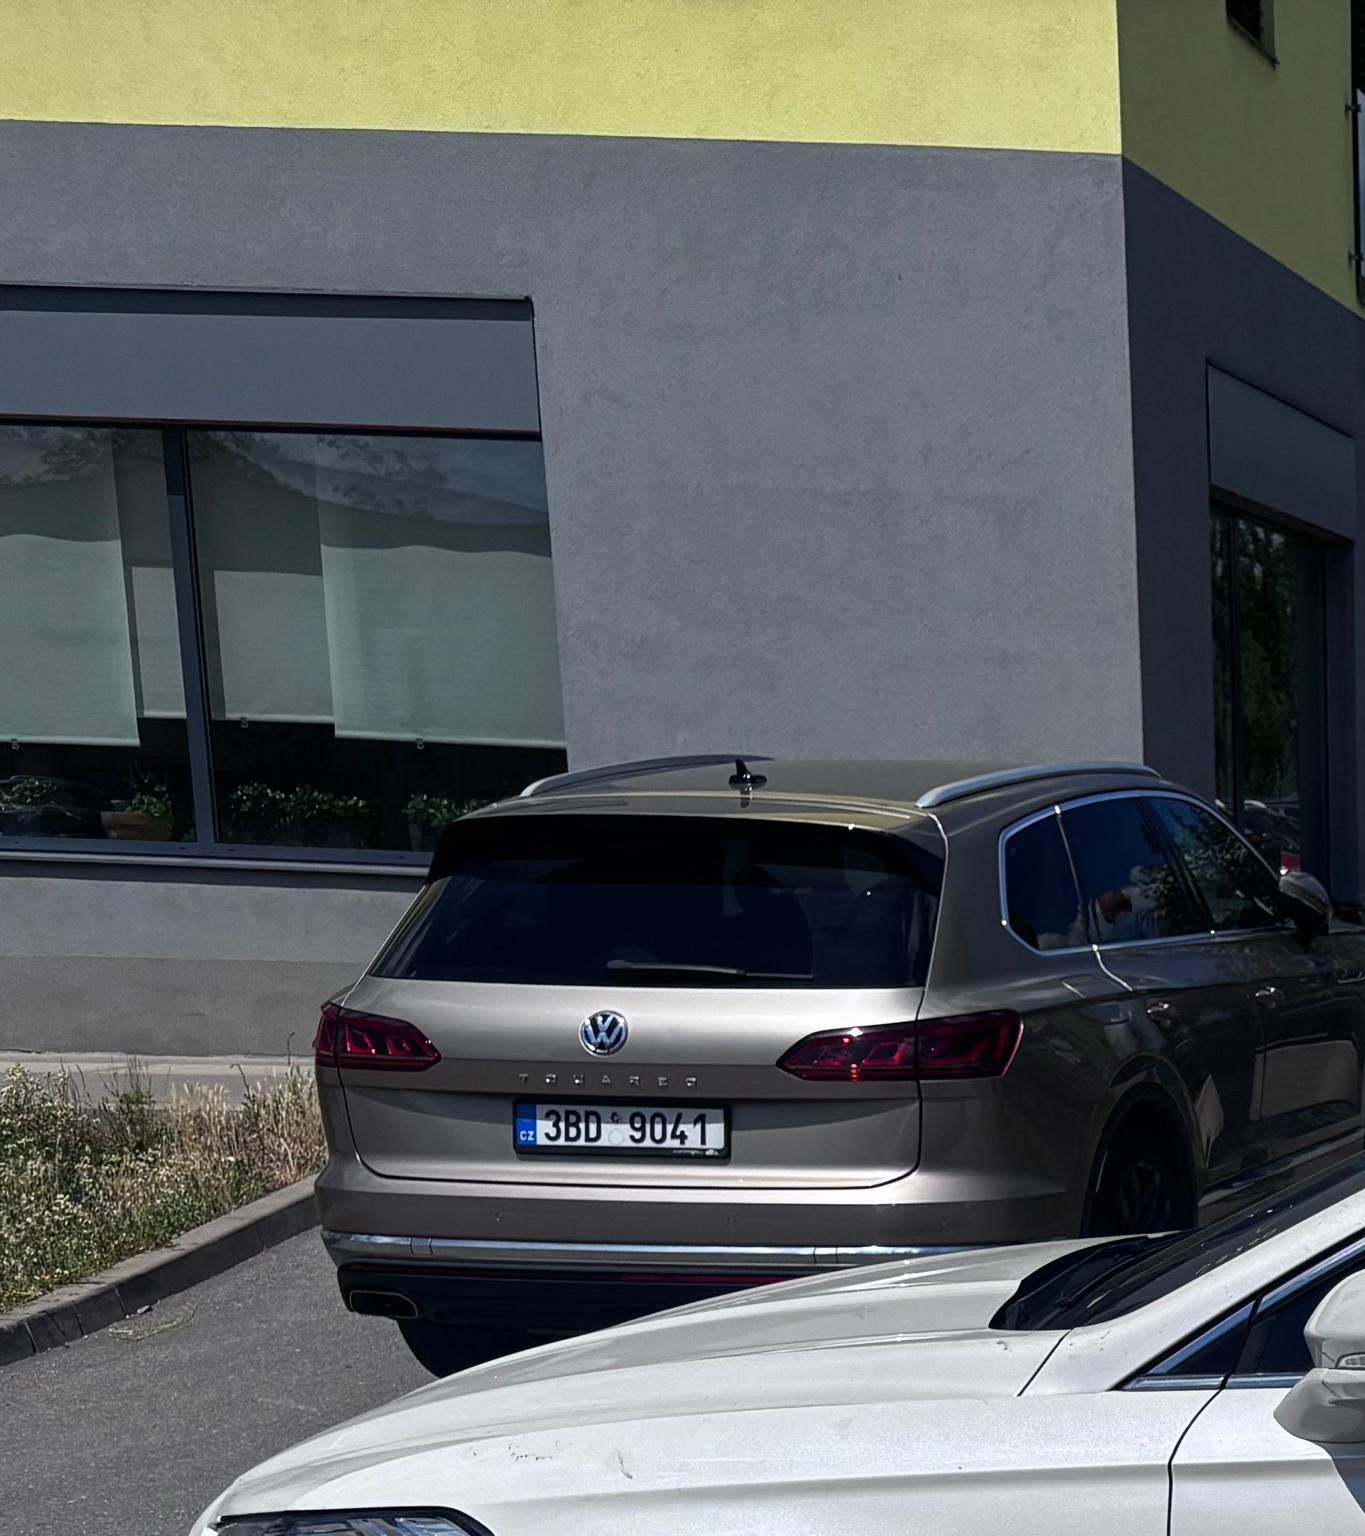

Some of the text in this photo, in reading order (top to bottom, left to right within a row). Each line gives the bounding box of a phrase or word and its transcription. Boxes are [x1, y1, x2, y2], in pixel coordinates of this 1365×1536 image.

[519, 1129, 535, 1141] CZ
[543, 1108, 707, 1146] 3BD 9041
